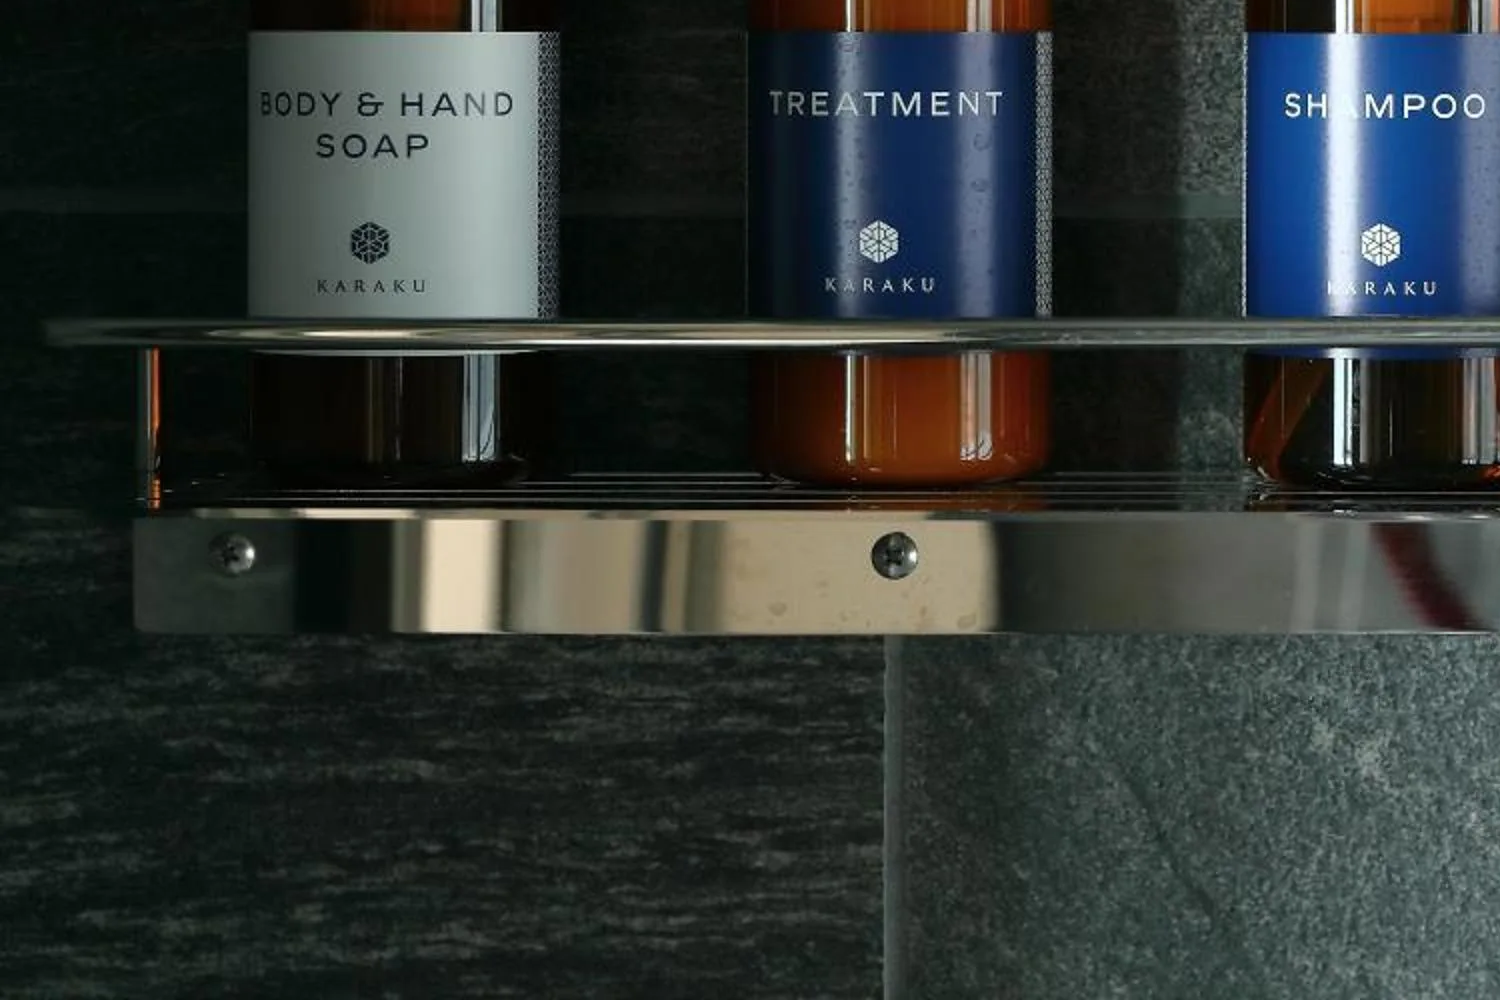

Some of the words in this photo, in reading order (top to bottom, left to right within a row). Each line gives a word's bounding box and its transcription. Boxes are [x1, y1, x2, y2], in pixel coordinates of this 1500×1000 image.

[260, 91, 342, 117] BODY
[357, 91, 384, 117] &
[400, 91, 514, 117] HAND
[769, 91, 1004, 117] TREATMENT
[315, 133, 430, 159] SOAP
[316, 279, 426, 294] KARAKU
[824, 277, 936, 294] KARAKU
